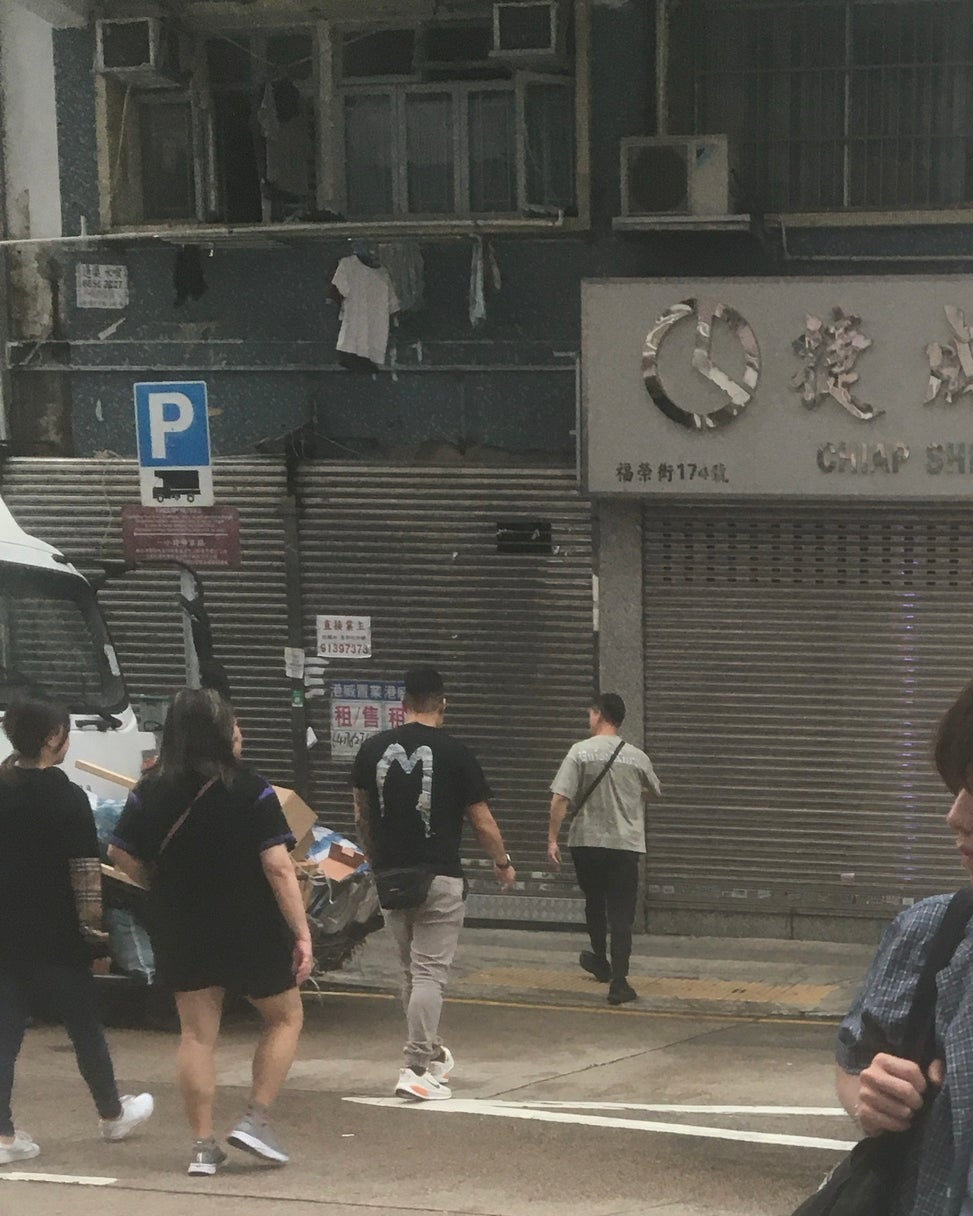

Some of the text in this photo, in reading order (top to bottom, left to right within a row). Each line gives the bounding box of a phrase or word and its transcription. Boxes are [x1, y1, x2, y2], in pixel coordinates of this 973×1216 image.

[148, 392, 195, 459] P
[816, 441, 910, 475] CHIAP
[335, 705, 379, 728] 租/售
